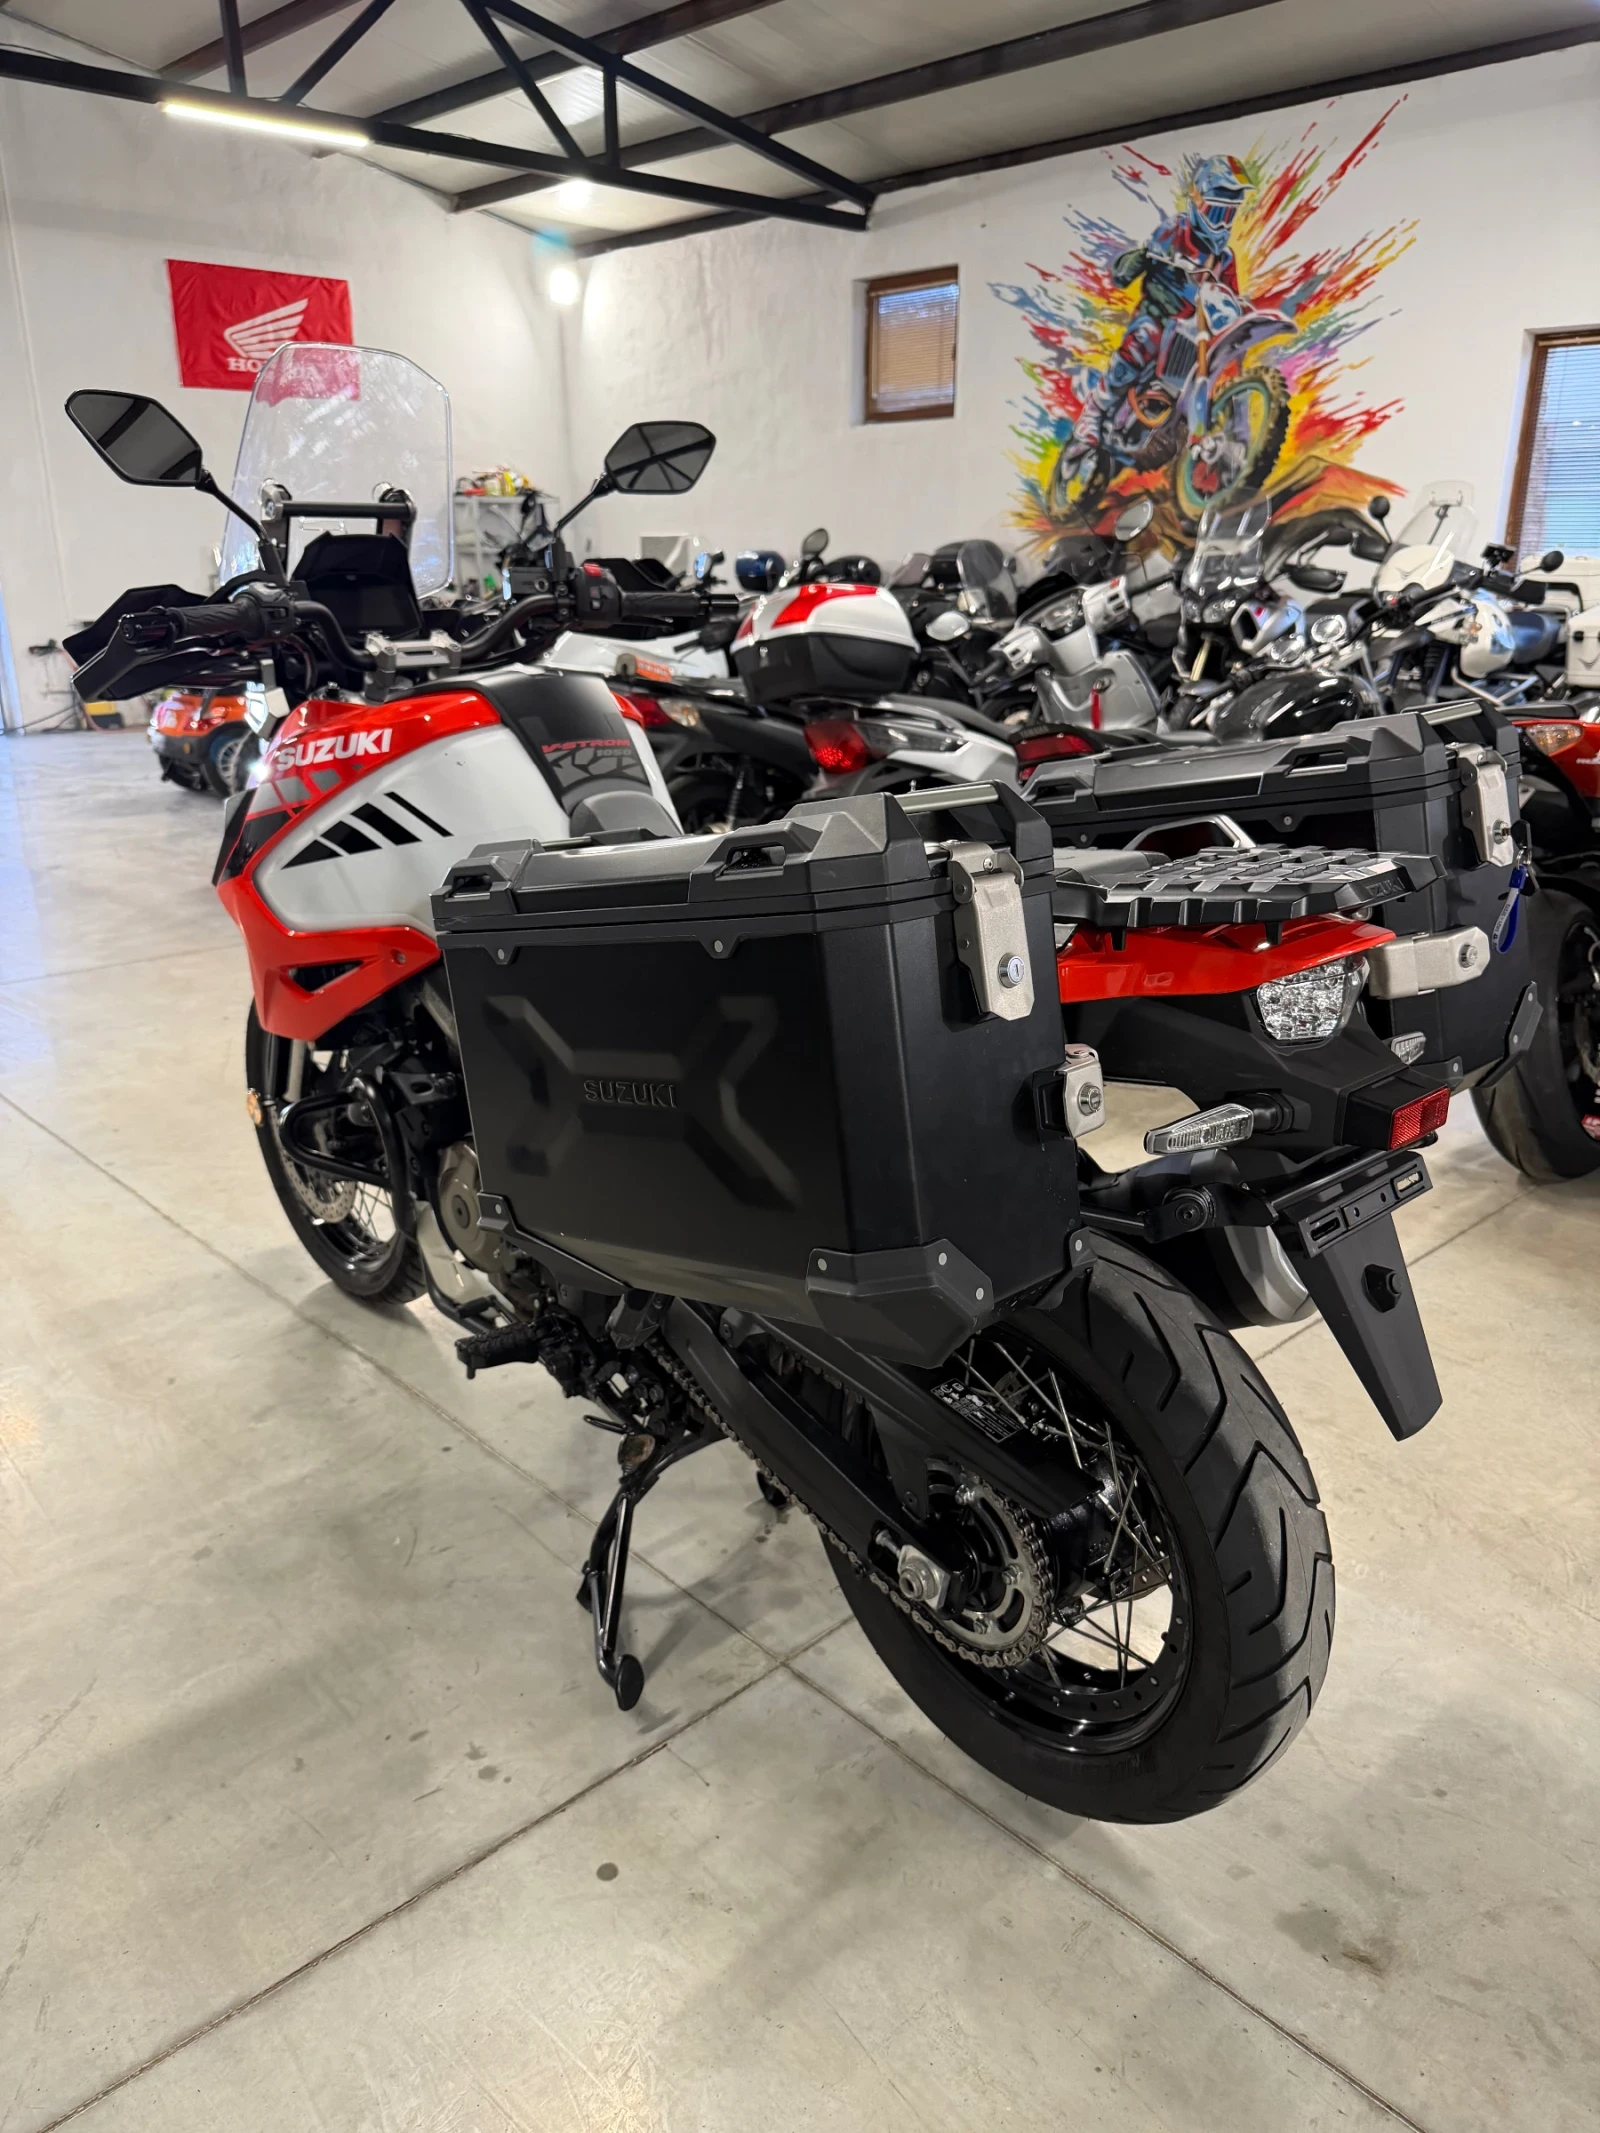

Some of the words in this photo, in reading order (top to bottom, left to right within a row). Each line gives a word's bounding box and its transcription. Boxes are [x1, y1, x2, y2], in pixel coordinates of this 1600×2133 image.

[276, 727, 393, 772] SUZUKI
[541, 739, 630, 753] V-STROM
[596, 748, 632, 757] 1050
[583, 1079, 678, 1109] SUZUKI
